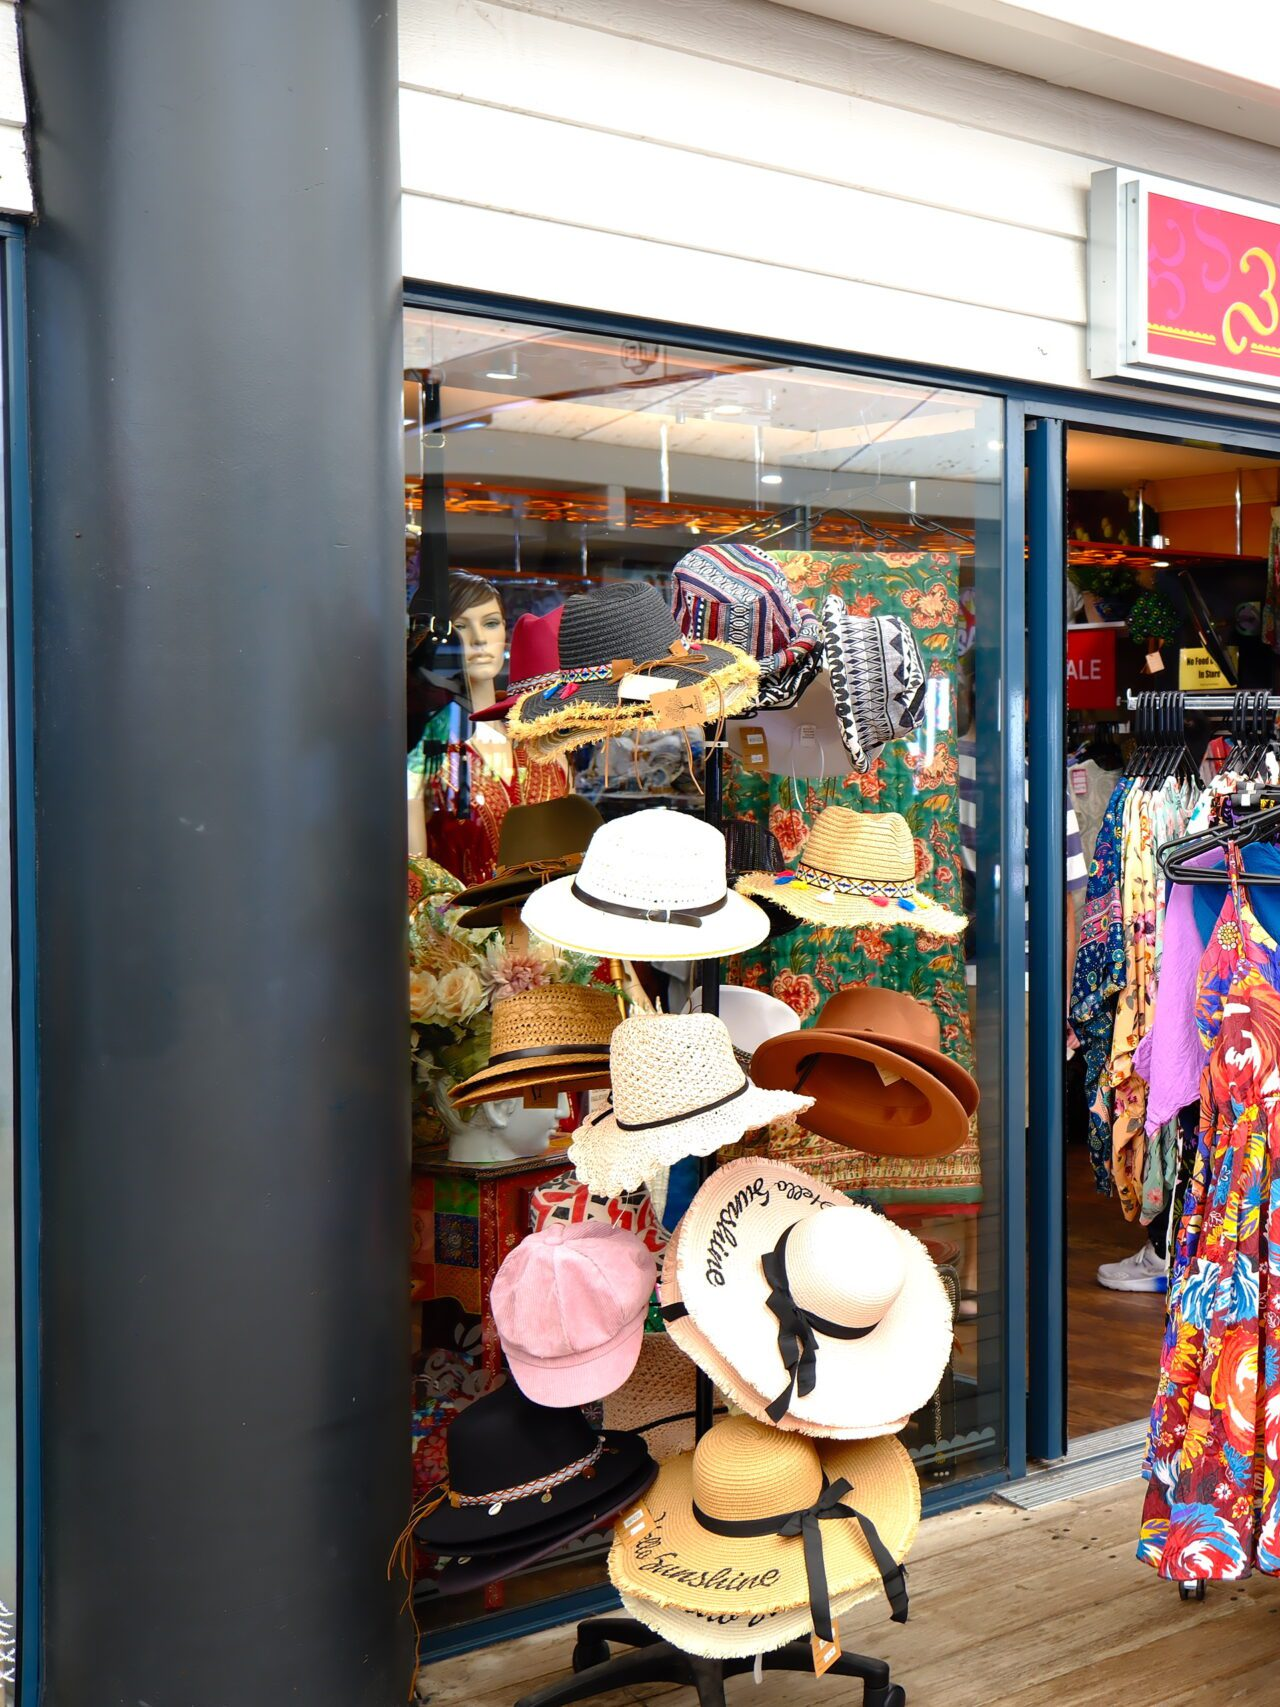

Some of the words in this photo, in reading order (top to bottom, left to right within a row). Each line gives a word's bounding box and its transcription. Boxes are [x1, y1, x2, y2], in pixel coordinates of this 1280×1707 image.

[1066, 658, 1102, 680] ALE
[1186, 657, 1195, 666] No
[1195, 656, 1209, 666] Food
[1198, 670, 1205, 679] In
[1205, 670, 1221, 679] Store
[705, 1177, 770, 1287] Sunshine
[638, 1552, 781, 1592] Sunshine
